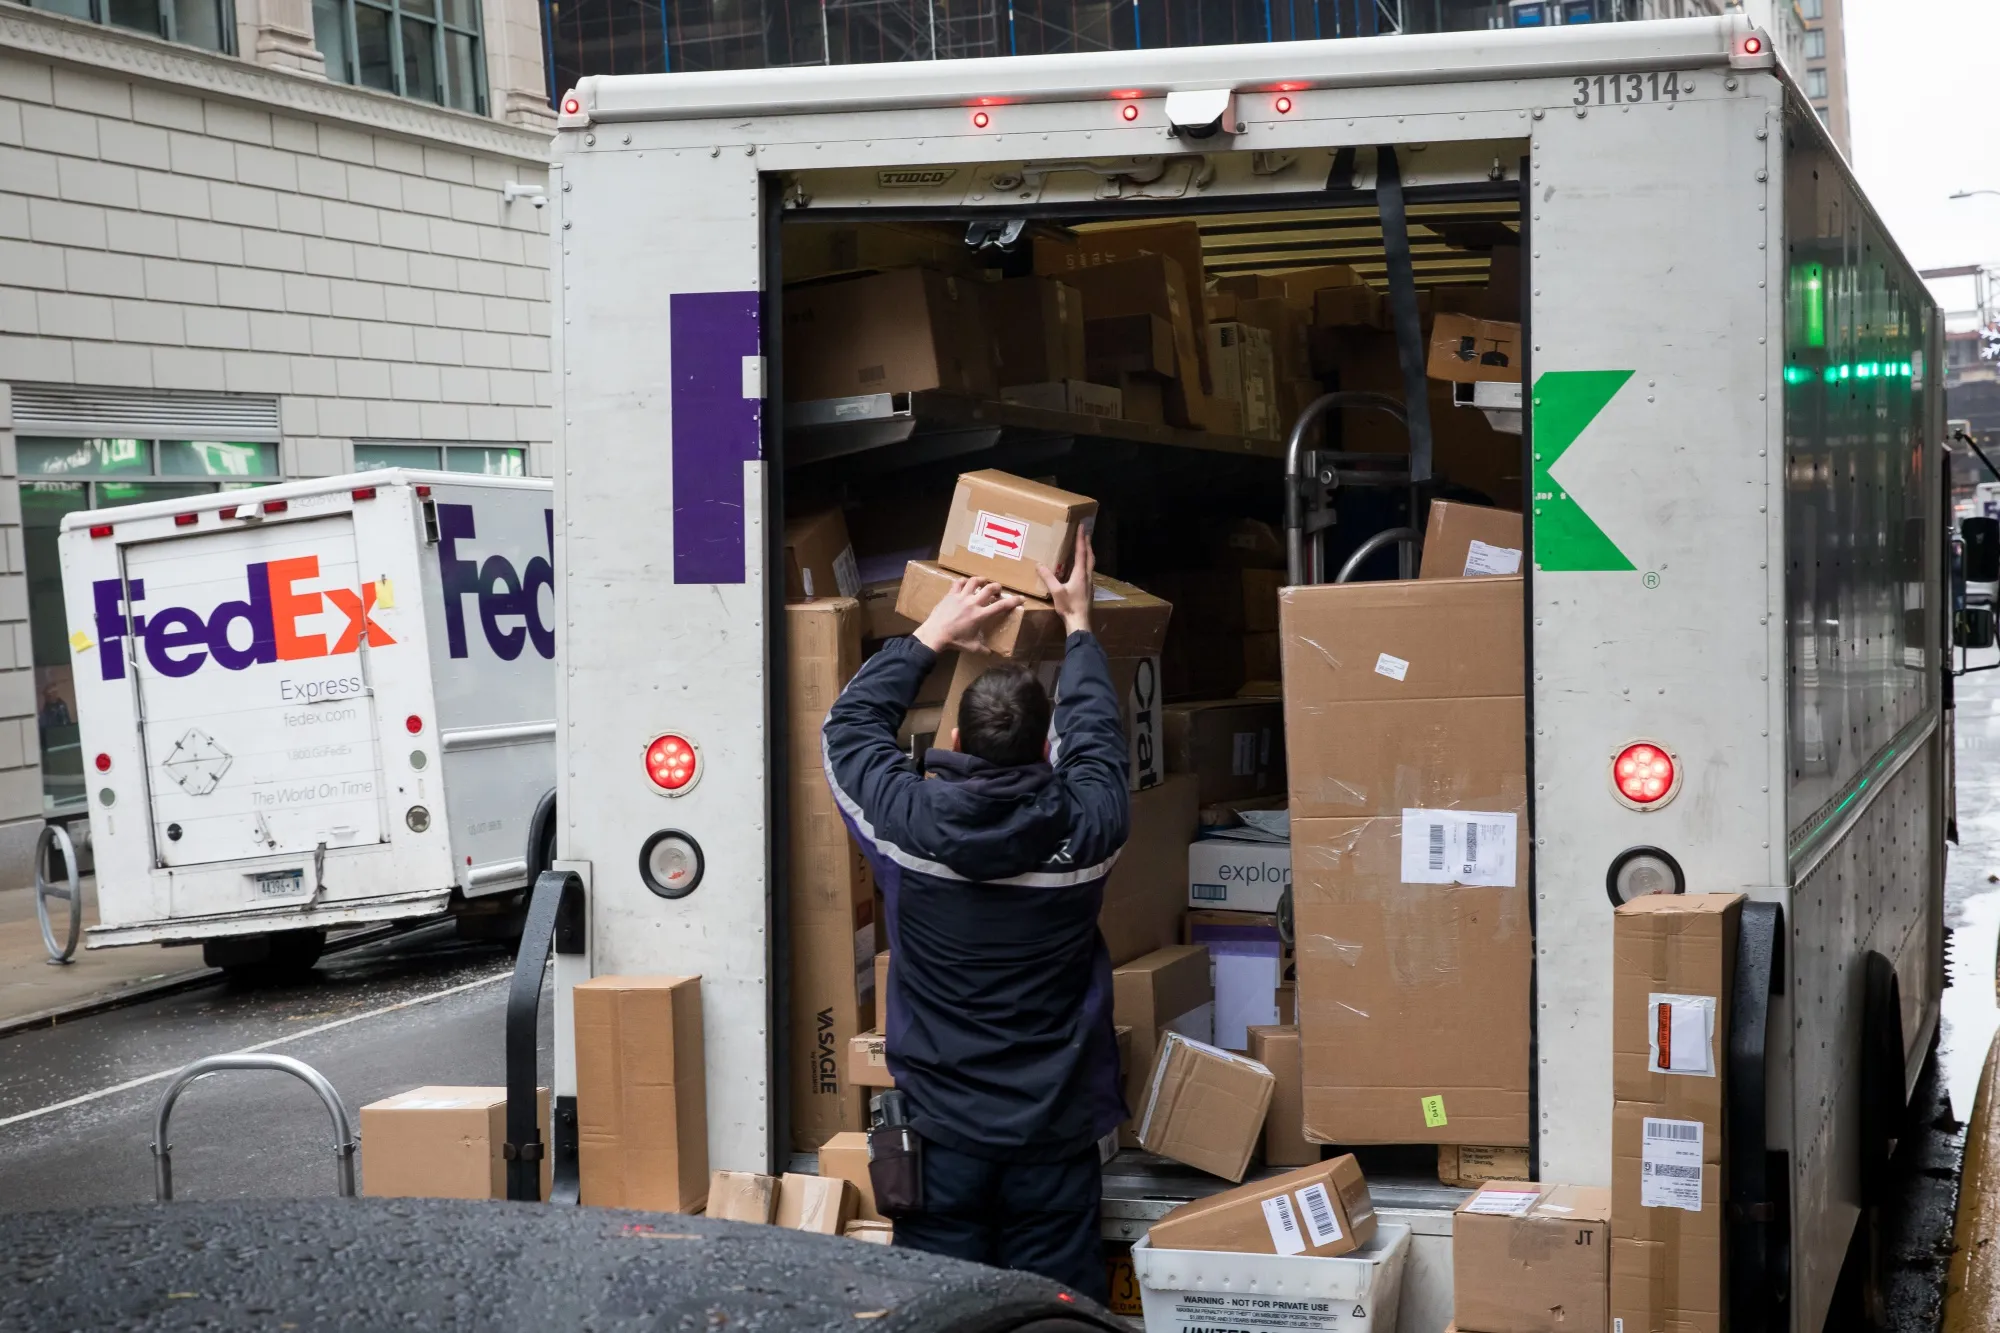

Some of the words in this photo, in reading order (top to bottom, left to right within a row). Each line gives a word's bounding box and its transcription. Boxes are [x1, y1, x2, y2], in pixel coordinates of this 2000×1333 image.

[1573, 72, 1679, 106] 311314
[882, 172, 944, 184] TODCO
[93, 554, 397, 681] FedEx
[280, 677, 361, 704] Express
[283, 708, 356, 727] fedex.com
[251, 791, 275, 806] The
[277, 785, 316, 804] World
[318, 783, 338, 798] On
[340, 780, 373, 796] Time
[1218, 861, 1291, 887] explor
[817, 1006, 837, 1094] VASAGLE
[1574, 1230, 1594, 1246] JT
[1183, 1295, 1225, 1305] WARNING
[1231, 1298, 1251, 1307] NOT
[1252, 1300, 1271, 1308] FOR
[1272, 1301, 1309, 1311] PRIVATE
[1310, 1303, 1329, 1312] USE
